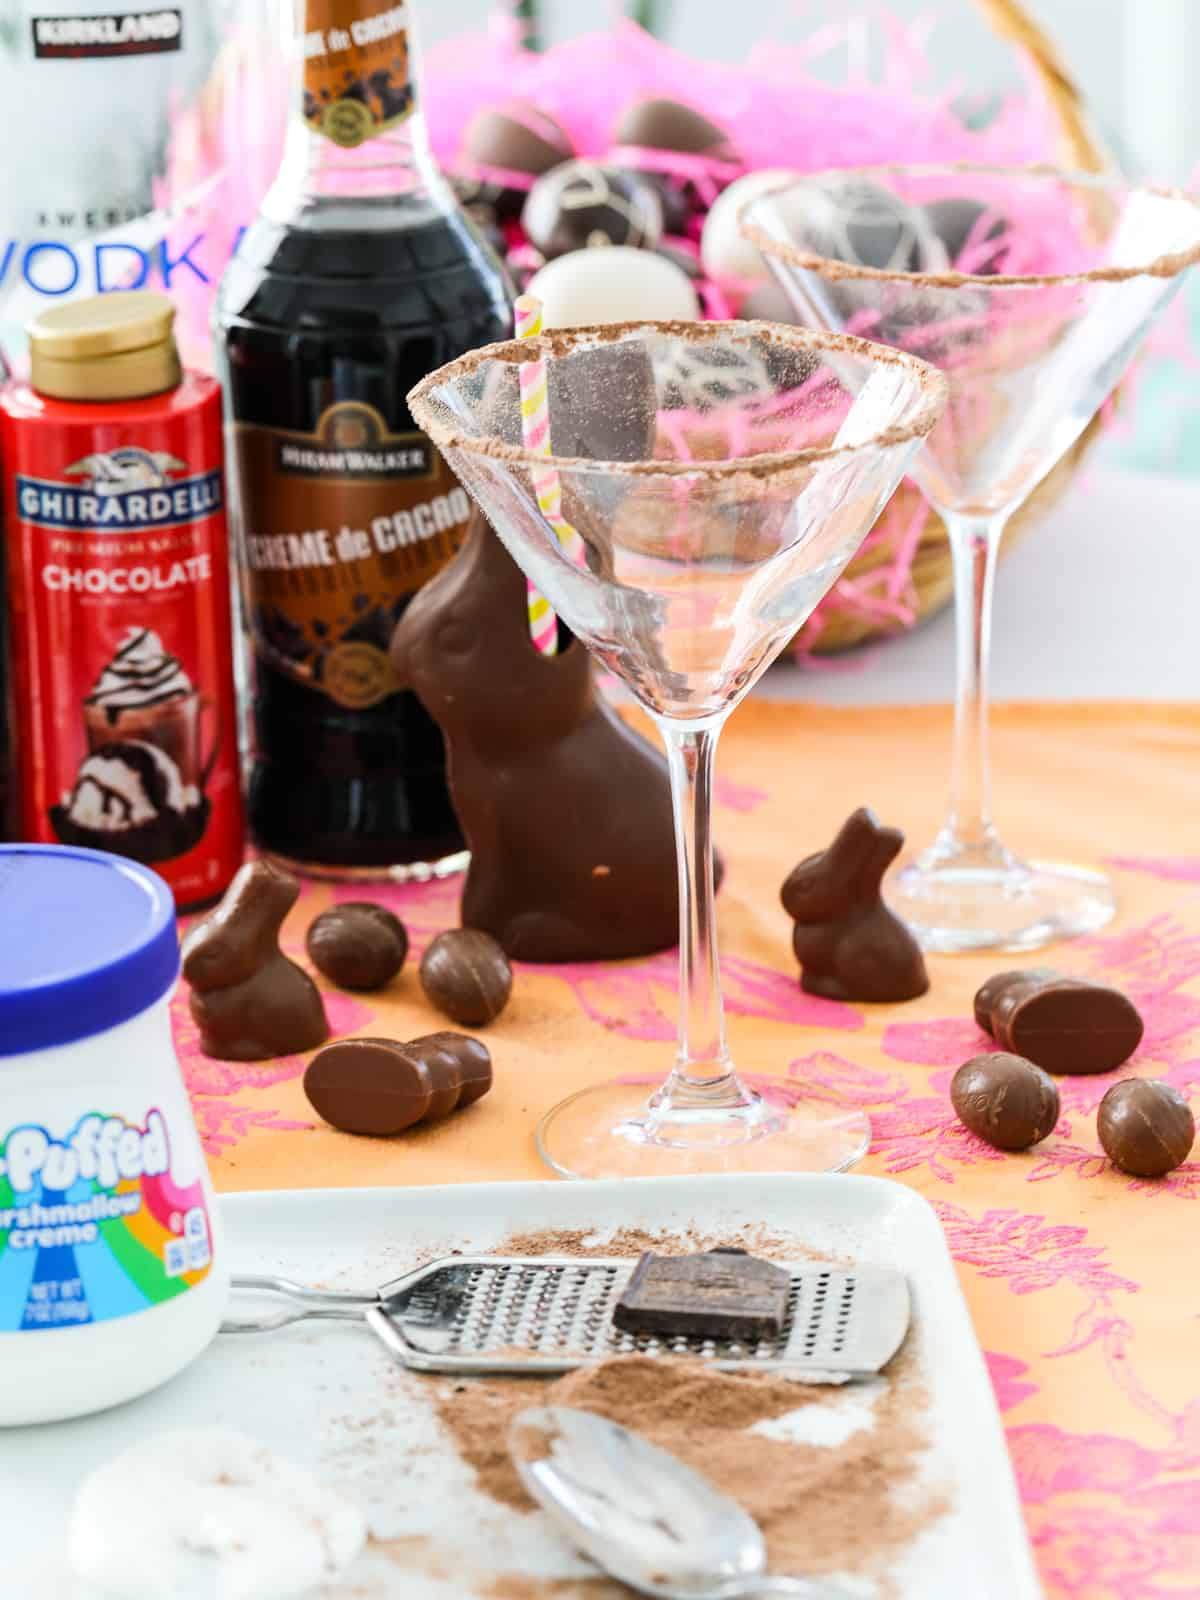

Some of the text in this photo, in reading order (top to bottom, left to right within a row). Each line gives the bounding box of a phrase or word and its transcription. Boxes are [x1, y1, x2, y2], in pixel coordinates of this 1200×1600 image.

[36, 11, 180, 45] KIRKLAND
[247, 528, 336, 570] CREME
[334, 524, 373, 563] de
[370, 484, 472, 555] CACAO
[41, 553, 212, 594] CHOCOLATE
[8, 1213, 99, 1248] creme
